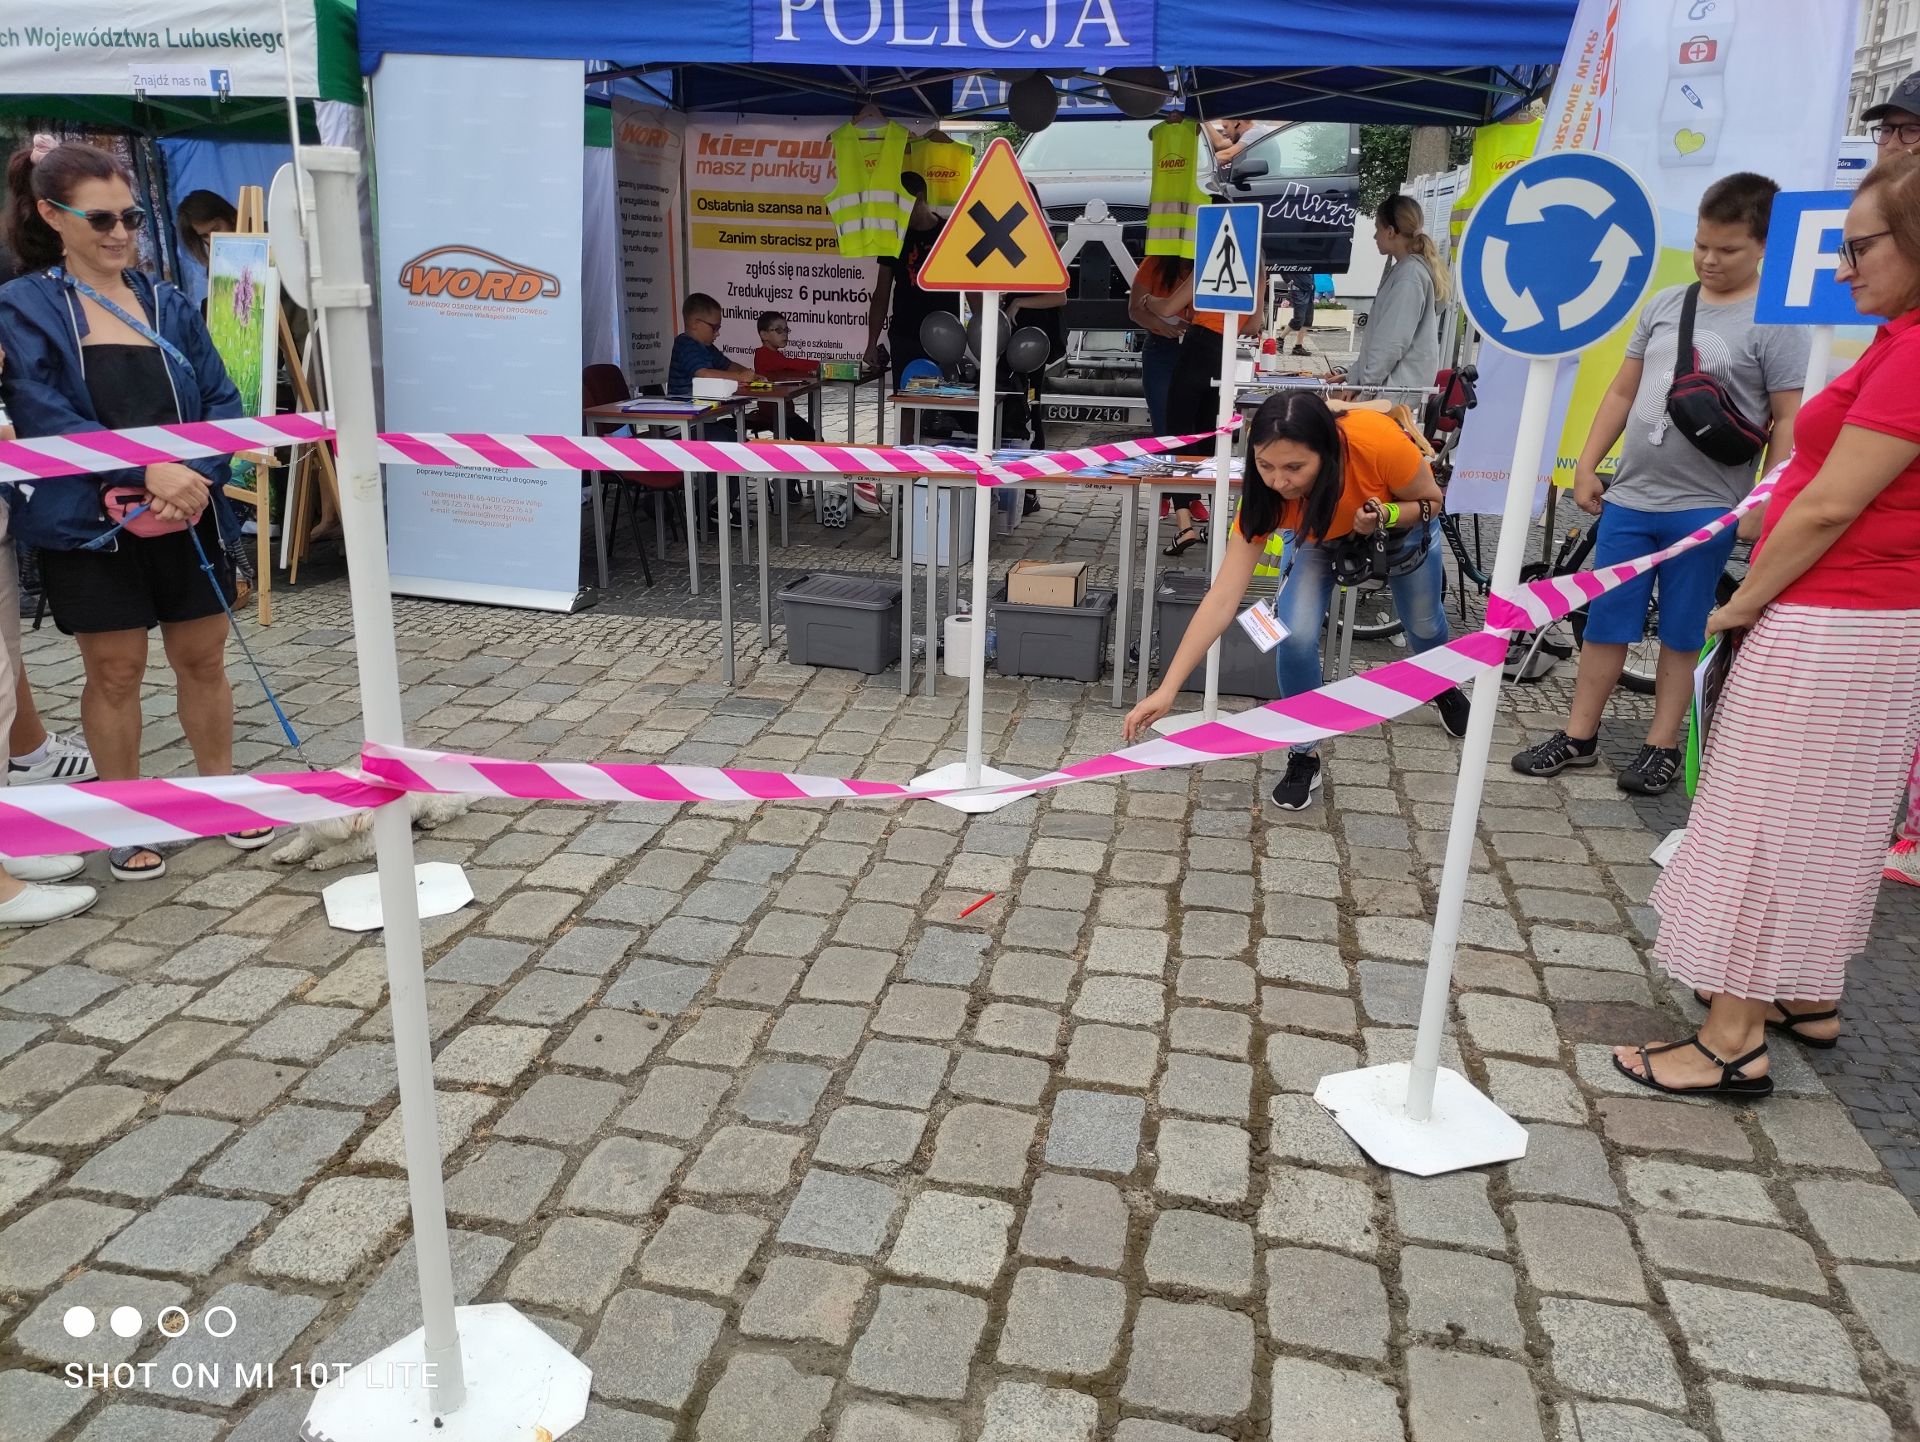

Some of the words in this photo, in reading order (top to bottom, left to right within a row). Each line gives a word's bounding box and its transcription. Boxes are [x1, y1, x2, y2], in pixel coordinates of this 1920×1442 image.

[774, 0, 1131, 49] POLICJA
[24, 27, 160, 52] Województwa
[133, 74, 169, 89] Znajdź
[172, 76, 190, 87] nas
[193, 77, 207, 87] na
[696, 160, 746, 176] masz
[751, 159, 821, 185] punkty
[1159, 158, 1186, 169] WORD
[925, 170, 956, 178] WORD
[697, 197, 754, 214] Ostatnia
[757, 200, 803, 215] szansa
[807, 204, 822, 215] na
[719, 231, 757, 245] Zanim
[760, 233, 812, 247] stracisz
[746, 260, 776, 280] zgłoś
[777, 262, 794, 280] się
[796, 265, 810, 277] na
[812, 263, 865, 280] szkolenie.
[409, 265, 544, 301] WORD
[727, 281, 793, 303] Zredukujesz
[799, 286, 808, 300] 6
[812, 339, 843, 350] szkoleniu
[1048, 406, 1080, 419] GOU
[1084, 406, 1122, 422] 7216
[416, 468, 443, 478] poprawy
[444, 469, 493, 481] bezpieczeństwa
[512, 475, 548, 487] drogowego
